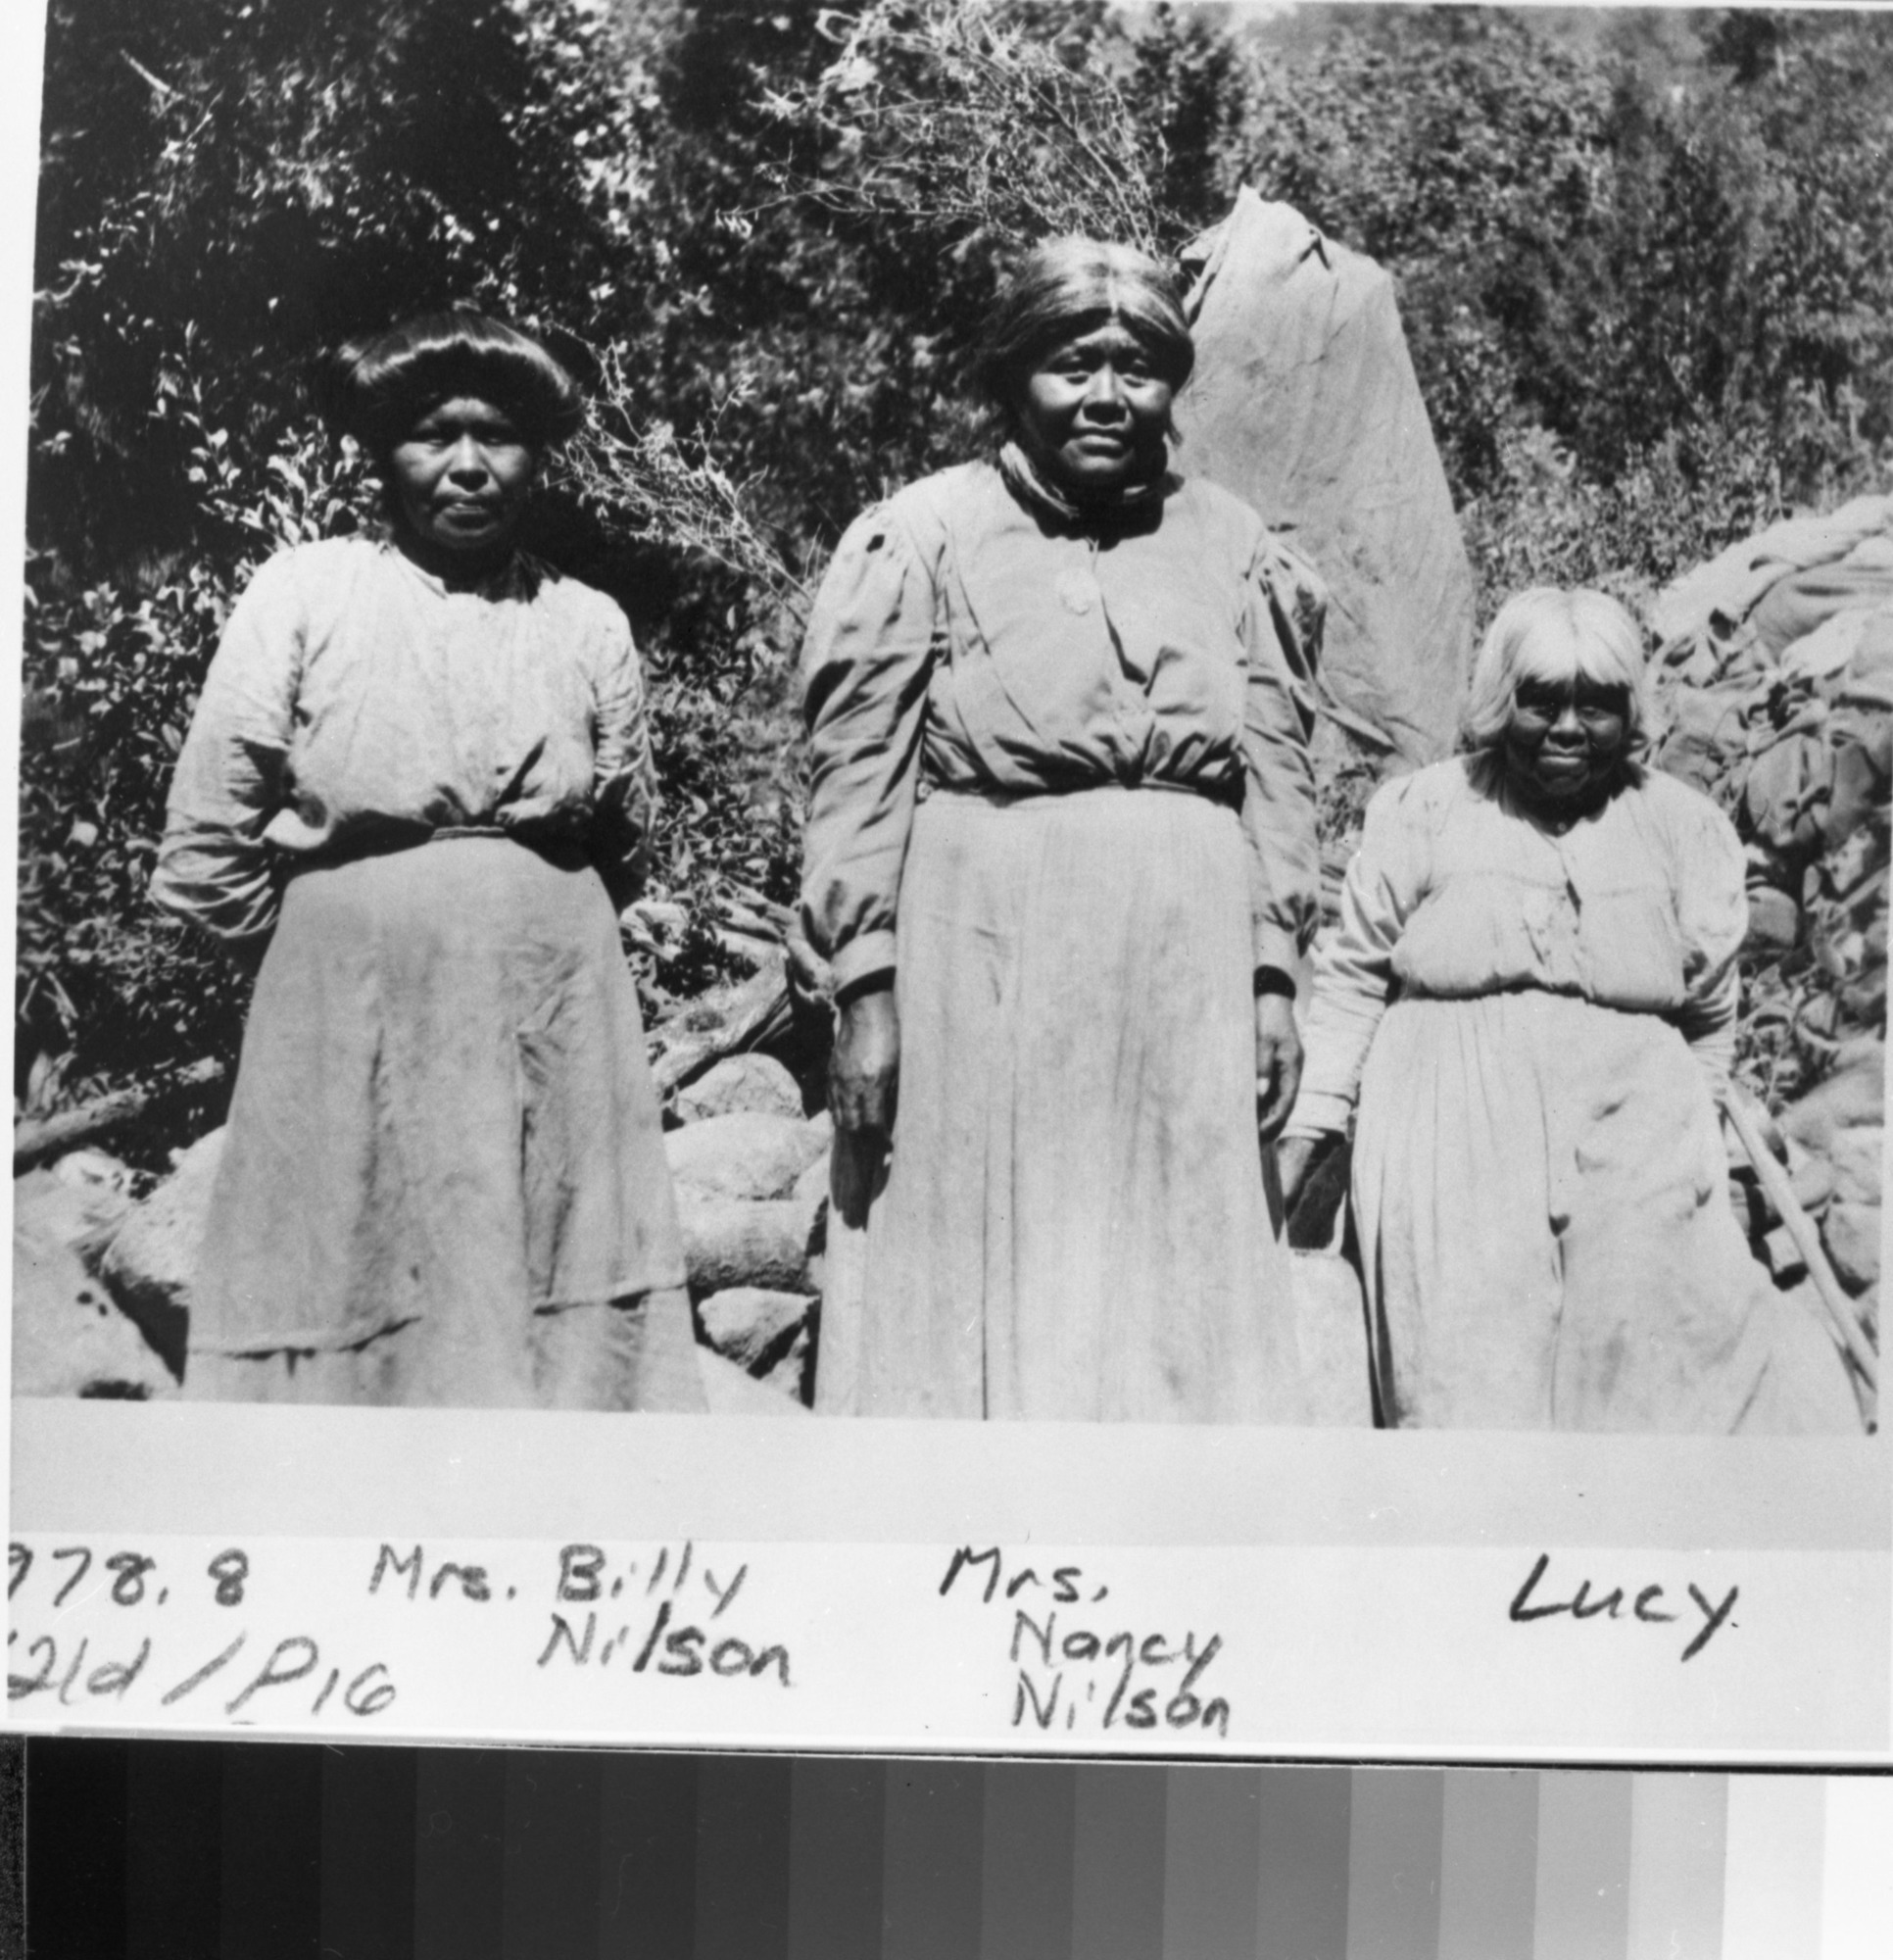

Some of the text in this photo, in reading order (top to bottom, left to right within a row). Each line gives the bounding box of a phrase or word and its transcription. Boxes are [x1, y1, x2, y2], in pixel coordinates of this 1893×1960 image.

[368, 1540, 748, 1619] Mrs. Billy
[938, 1545, 1108, 1604] Mrs.
[536, 1600, 791, 1688] Nilson
[1010, 1609, 1224, 1693] Nancy
[1012, 1668, 1231, 1739] Nilson
